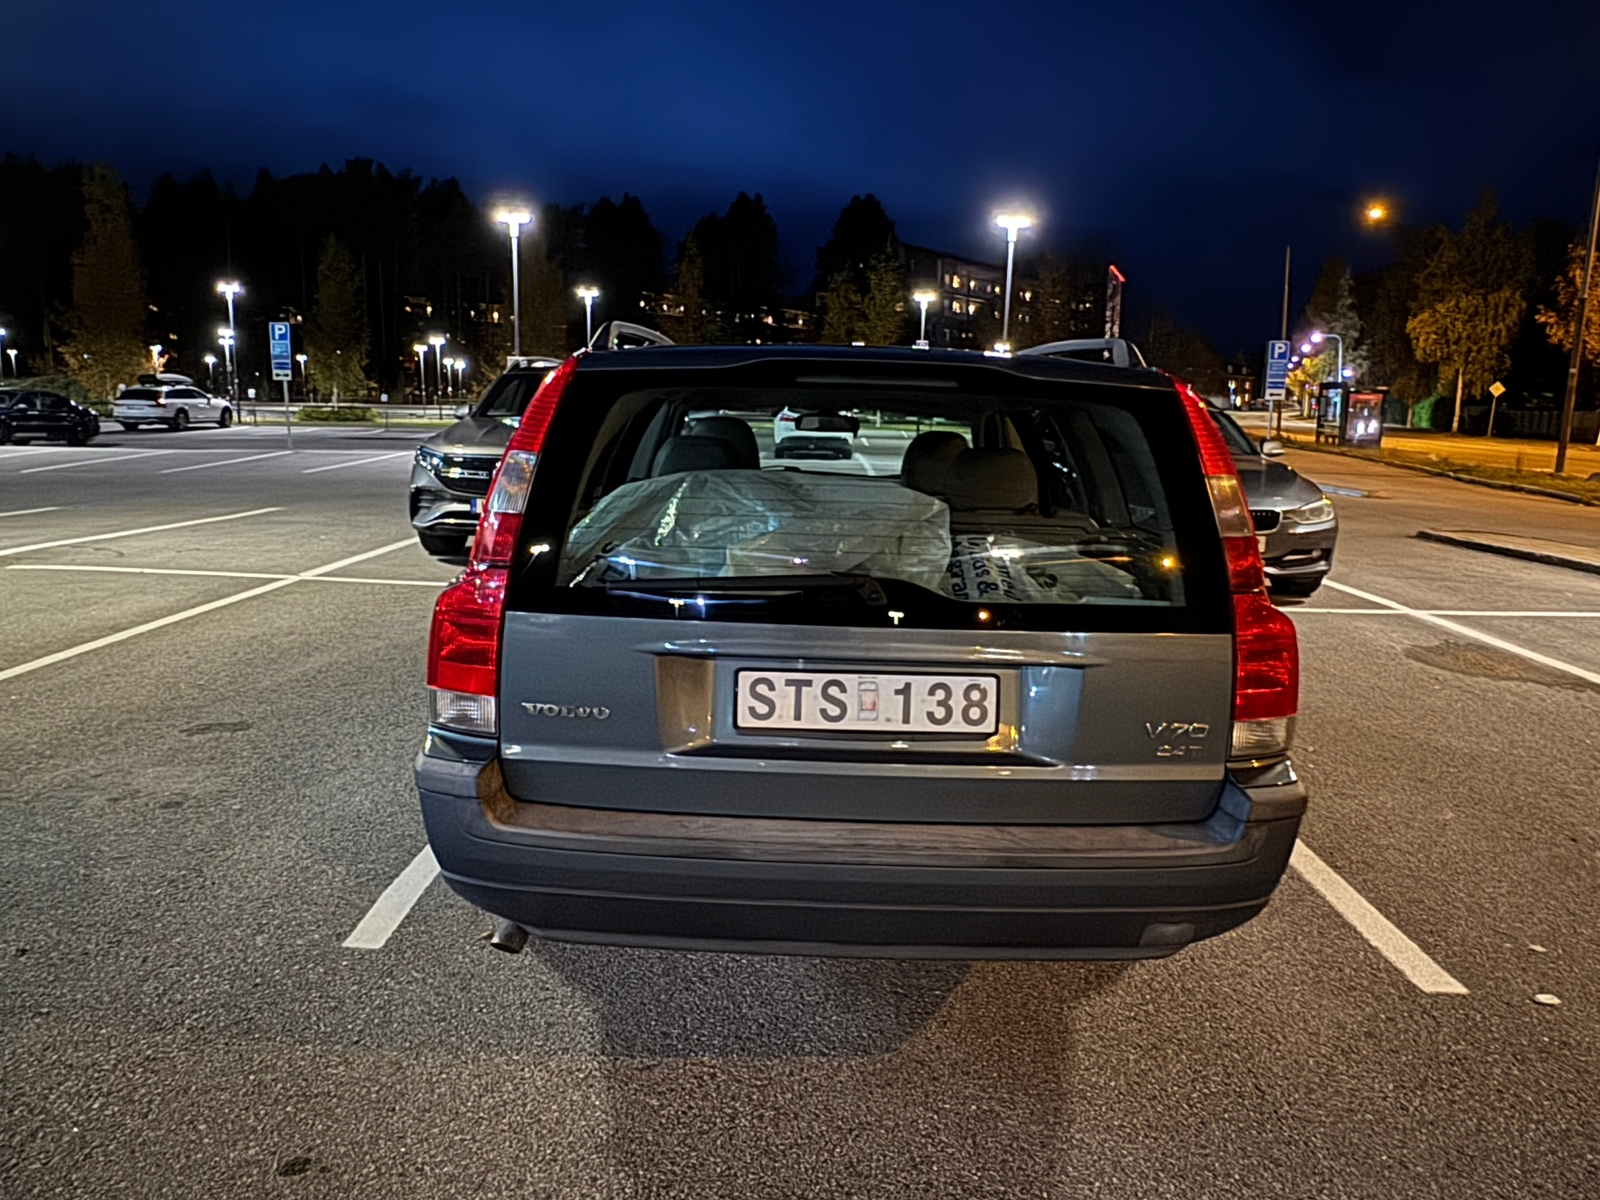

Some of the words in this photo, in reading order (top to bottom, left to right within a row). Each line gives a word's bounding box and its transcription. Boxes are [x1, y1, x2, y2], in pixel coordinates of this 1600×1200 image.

[274, 324, 286, 340] P
[1273, 343, 1286, 359] P
[747, 677, 848, 723] STS
[894, 682, 988, 727] 138
[521, 702, 610, 720] VOLVO
[1145, 722, 1210, 739] V70
